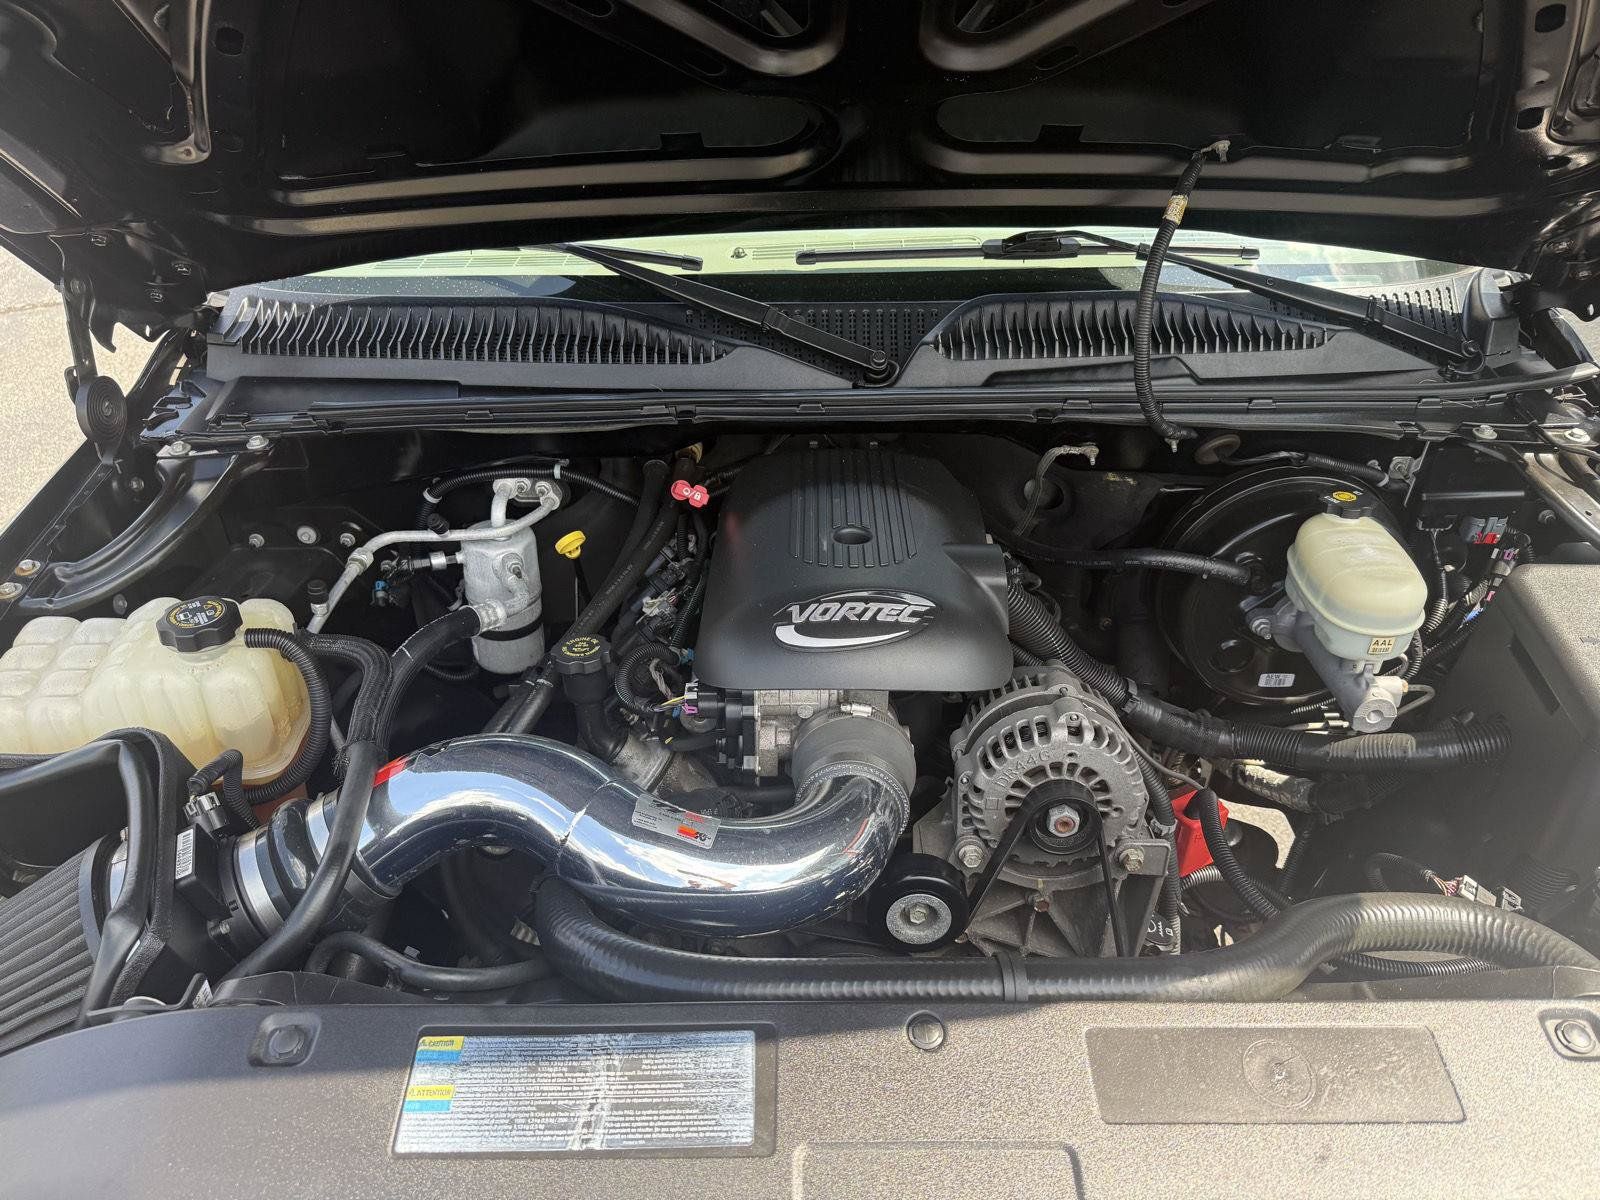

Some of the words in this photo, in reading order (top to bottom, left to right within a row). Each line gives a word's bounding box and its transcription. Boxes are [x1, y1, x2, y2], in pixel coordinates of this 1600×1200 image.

[786, 601, 931, 624] VORTEC
[1372, 639, 1392, 647] AAL
[416, 1088, 452, 1096] ATTENTION
